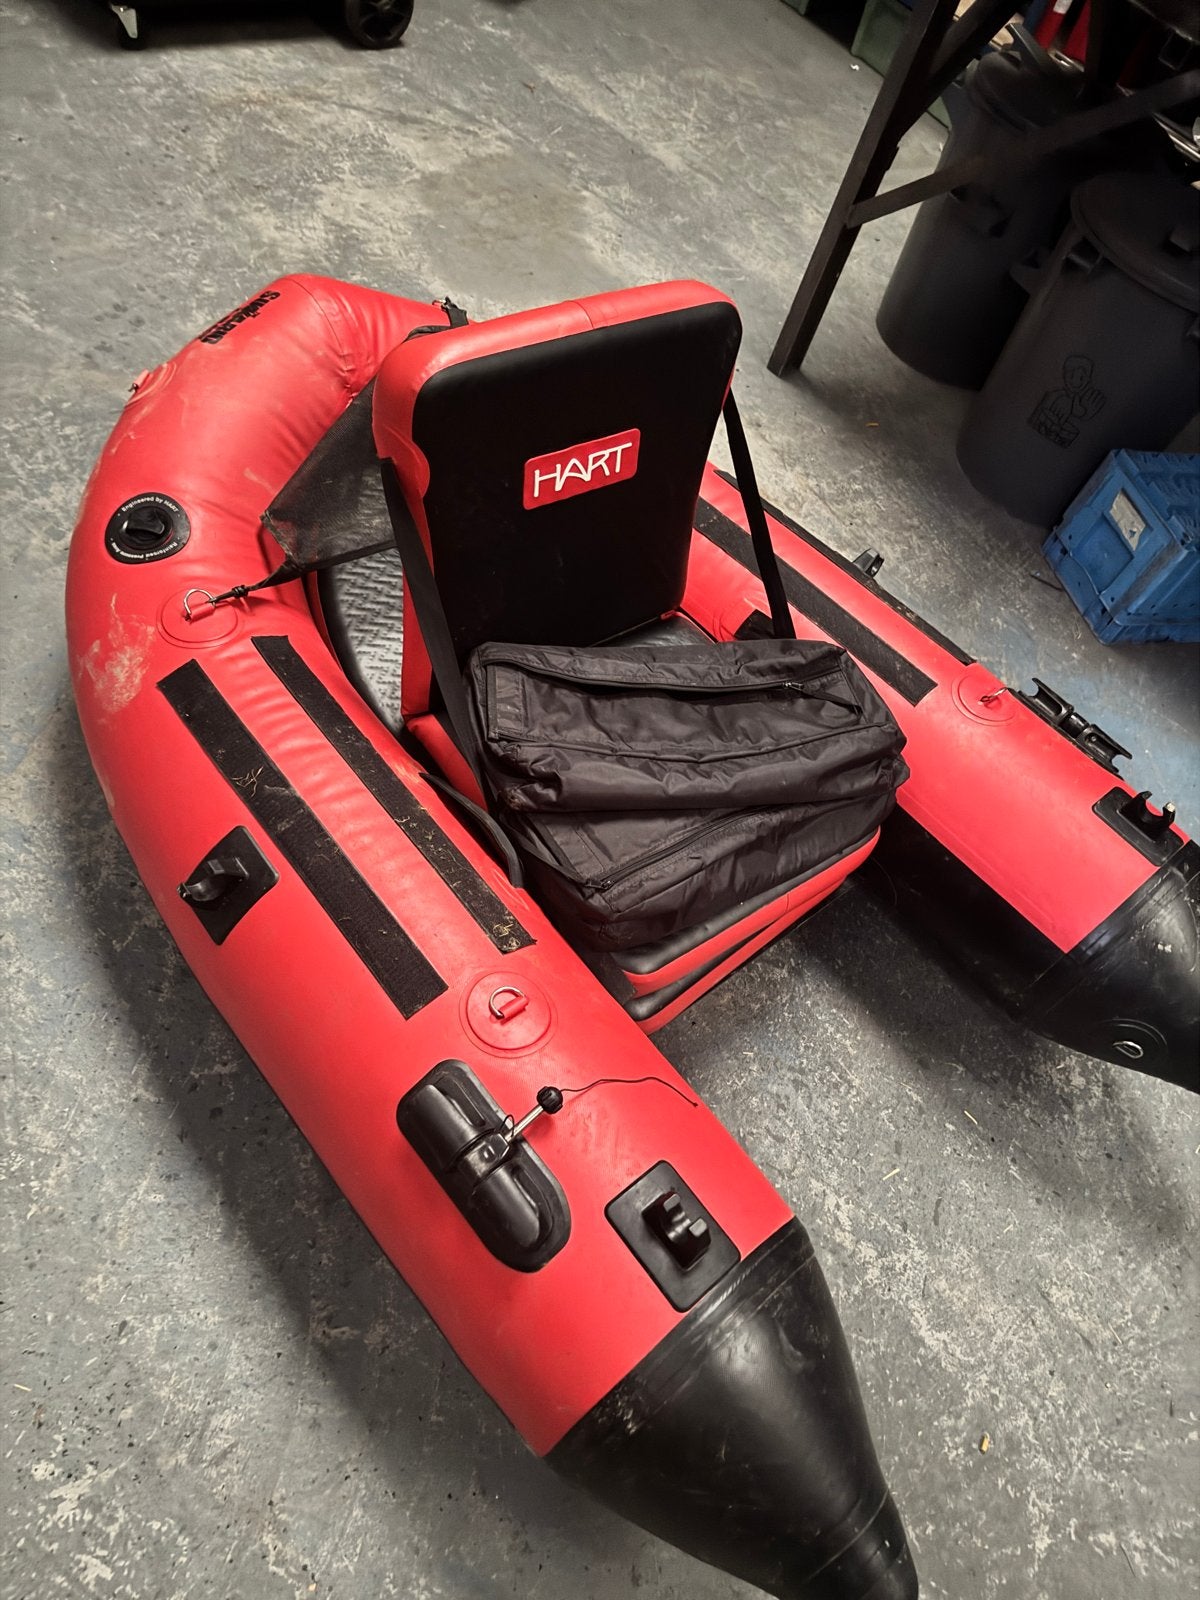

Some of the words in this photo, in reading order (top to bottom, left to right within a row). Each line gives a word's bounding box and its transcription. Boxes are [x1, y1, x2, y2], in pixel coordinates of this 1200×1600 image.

[533, 442, 633, 498] HART
[121, 496, 154, 512] Engineered
[163, 500, 179, 512] HART
